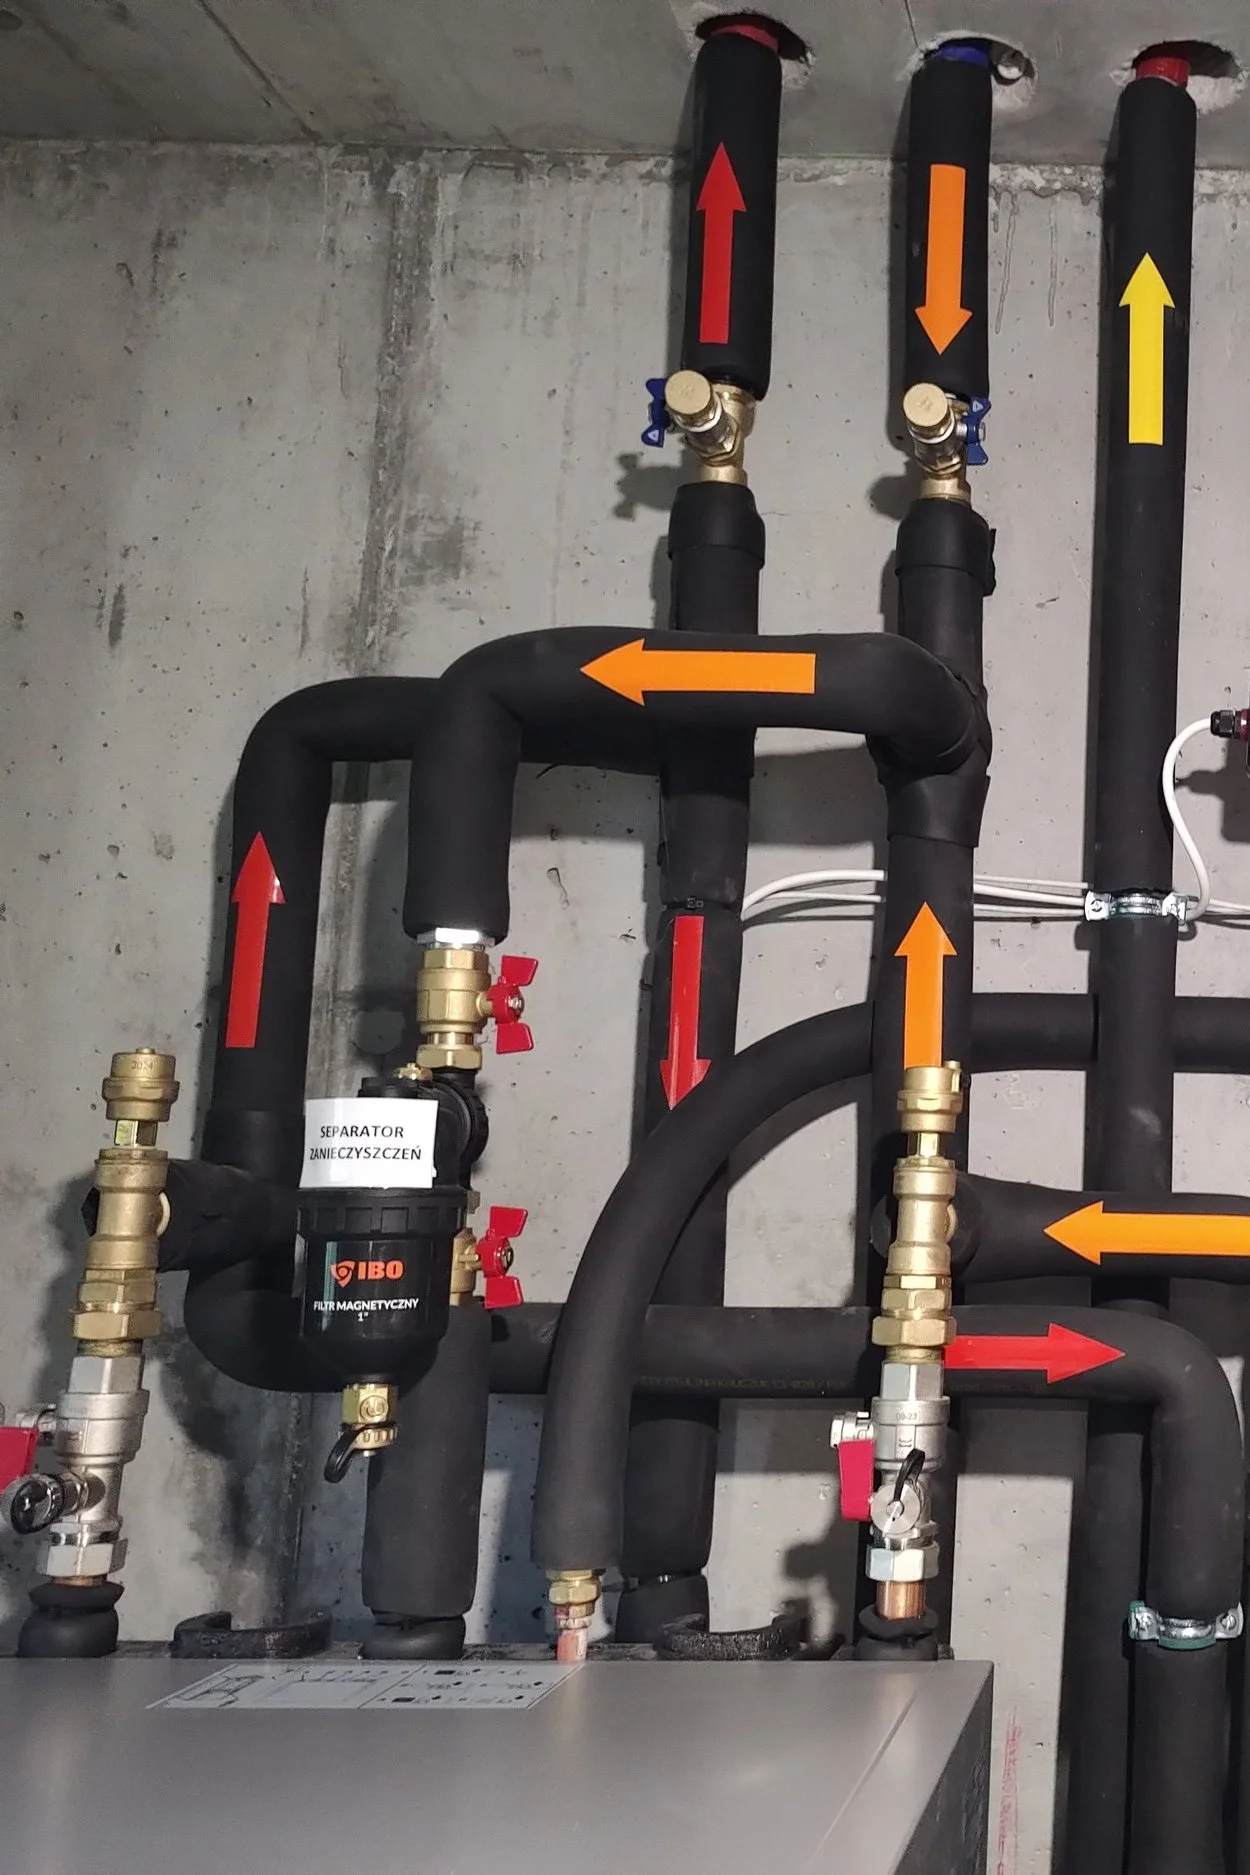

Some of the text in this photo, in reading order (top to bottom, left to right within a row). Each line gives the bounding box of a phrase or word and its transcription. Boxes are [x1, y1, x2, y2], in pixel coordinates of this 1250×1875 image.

[320, 1125, 404, 1138] SEPARATOR
[309, 1145, 422, 1161] ZANIECZYSZCZEŃ
[358, 1260, 403, 1281] IBO
[313, 1298, 419, 1311] FILTR MAGNETYCZNY
